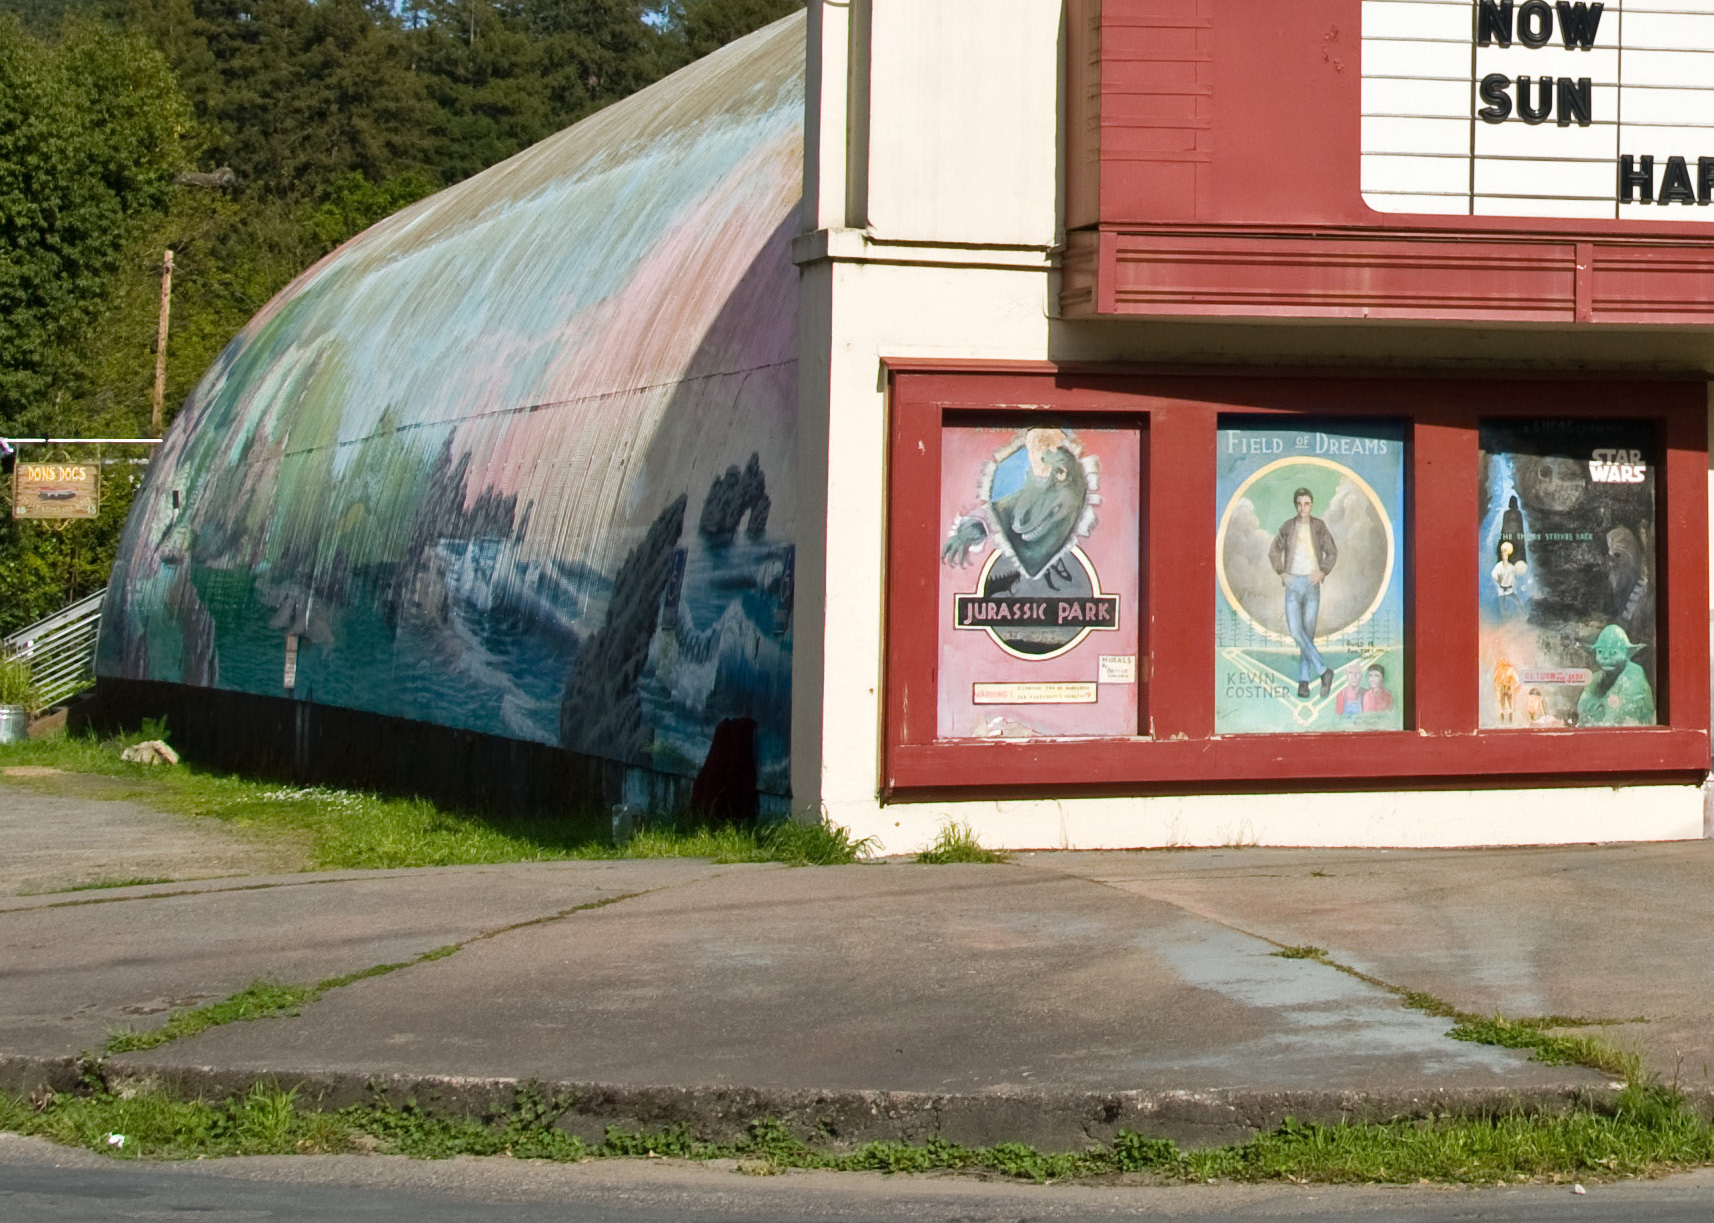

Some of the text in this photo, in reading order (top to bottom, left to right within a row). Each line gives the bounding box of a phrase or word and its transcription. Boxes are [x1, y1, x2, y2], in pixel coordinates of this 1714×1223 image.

[1477, 73, 1593, 127] SUN
[1588, 448, 1646, 466] STAR
[1589, 465, 1647, 483] WARS
[963, 601, 1110, 625] JURASSIC PARK
[1226, 671, 1276, 685] KEVIN
[1225, 685, 1291, 699] COSTNER
